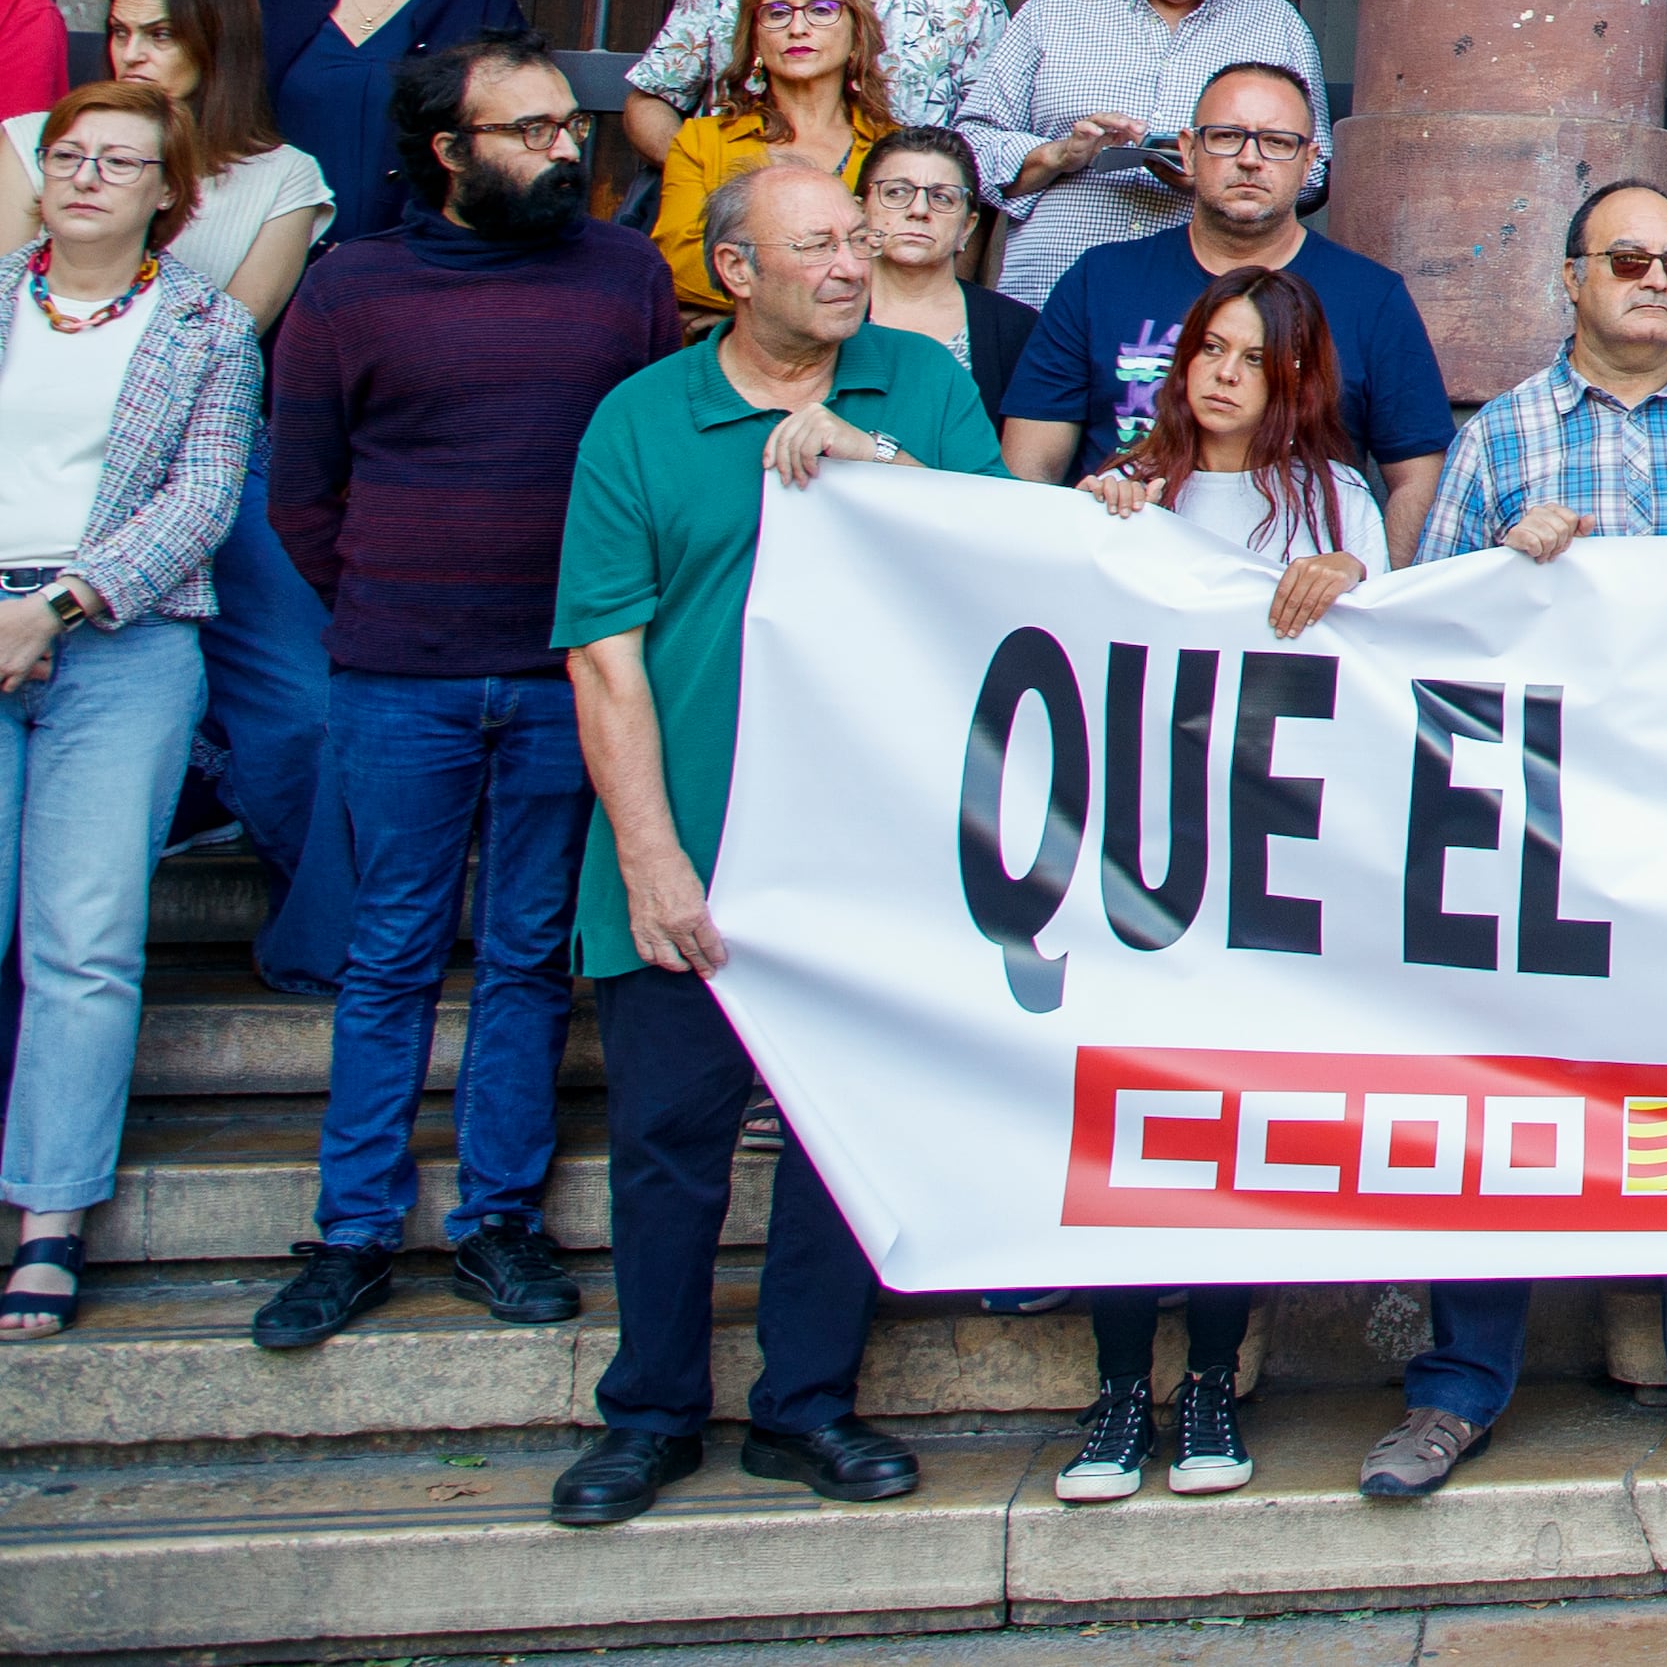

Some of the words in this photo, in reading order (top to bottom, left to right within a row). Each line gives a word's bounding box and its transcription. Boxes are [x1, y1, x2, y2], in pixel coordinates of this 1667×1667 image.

[957, 626, 1340, 1013] QUE
[1403, 678, 1612, 979] EL
[1108, 1088, 1586, 1196] CCOO
